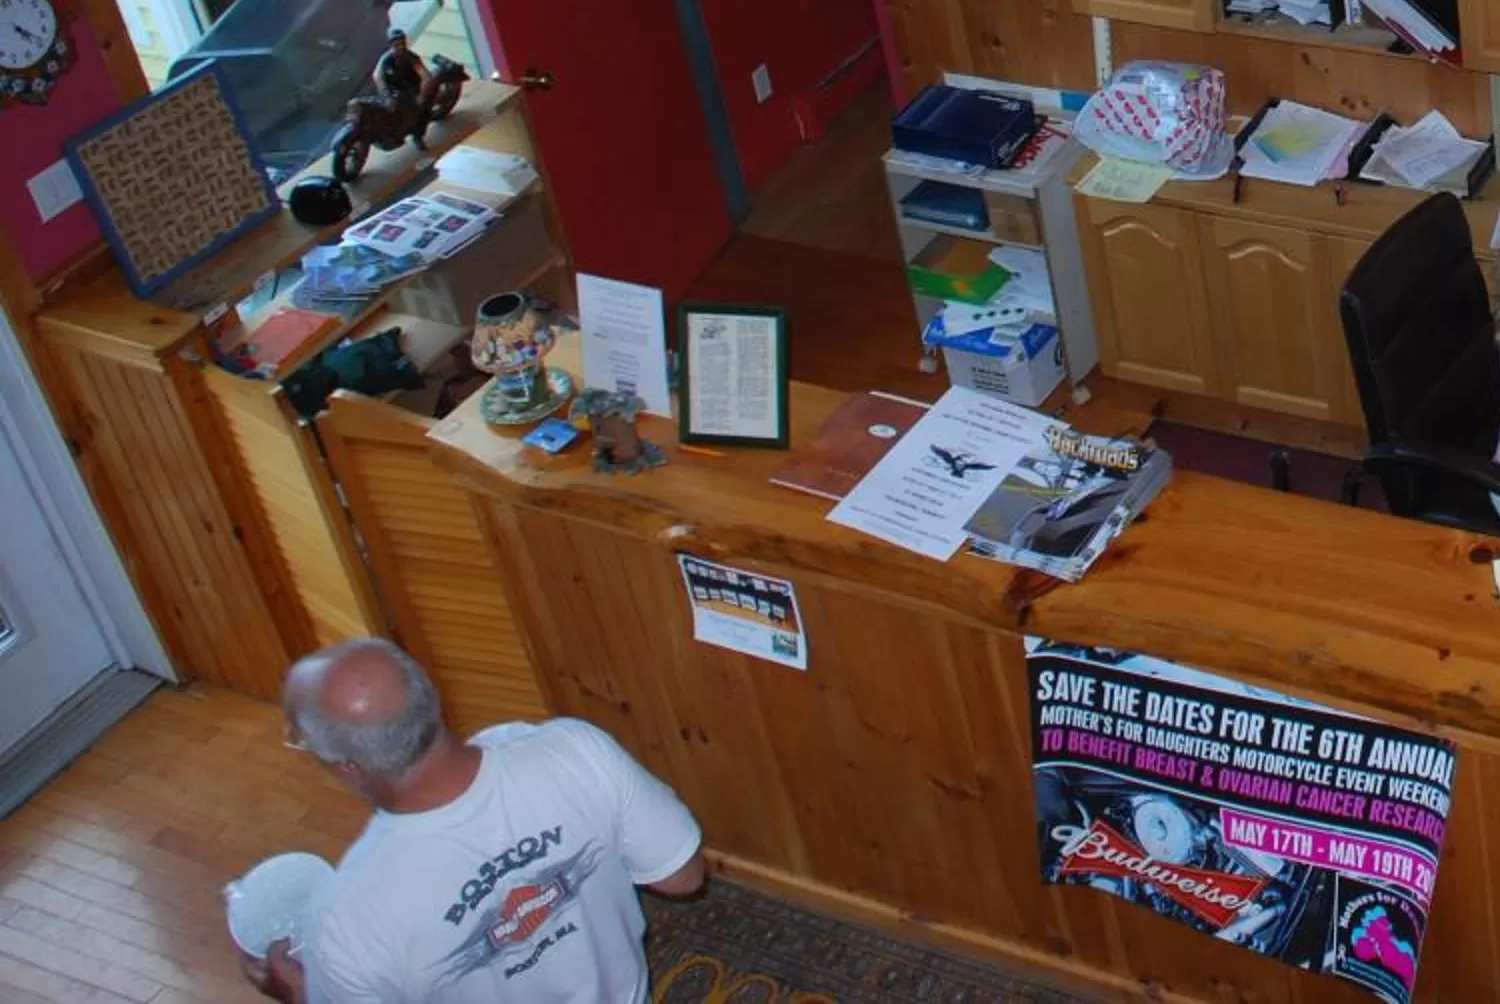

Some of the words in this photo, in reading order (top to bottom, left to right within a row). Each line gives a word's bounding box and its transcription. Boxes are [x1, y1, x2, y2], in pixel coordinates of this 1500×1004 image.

[1037, 670, 1095, 707] SAVE
[1101, 680, 1140, 717] THE
[1145, 691, 1216, 734] DATES
[1220, 707, 1264, 745] FOR
[1271, 719, 1314, 755] THE
[1318, 728, 1361, 765] 6TH
[1367, 739, 1456, 792] ANNUAL
[1040, 705, 1113, 735] MOTHER'S
[1116, 717, 1144, 744] FOR
[1145, 726, 1230, 764] DAUGHTERS
[1233, 747, 1333, 786] MOTORCYCLE
[1335, 768, 1385, 795] EVENT
[1388, 780, 1451, 820] WEEKEN
[1040, 729, 1062, 753] TO
[1067, 733, 1130, 766] BENEFIT
[1134, 748, 1198, 785] BREAST
[1200, 765, 1213, 787] &
[1218, 768, 1292, 806] OVARIAN
[1296, 785, 1365, 821] CANCER
[1370, 800, 1447, 842] RESEARC
[444, 824, 562, 926] BOSTON
[1052, 824, 1266, 916] Budweiser
[1229, 818, 1266, 848] MAY
[1271, 827, 1313, 858] 17TH
[1328, 840, 1367, 871] MAY
[1370, 849, 1414, 882] 19TH
[1415, 863, 1437, 895] 20
